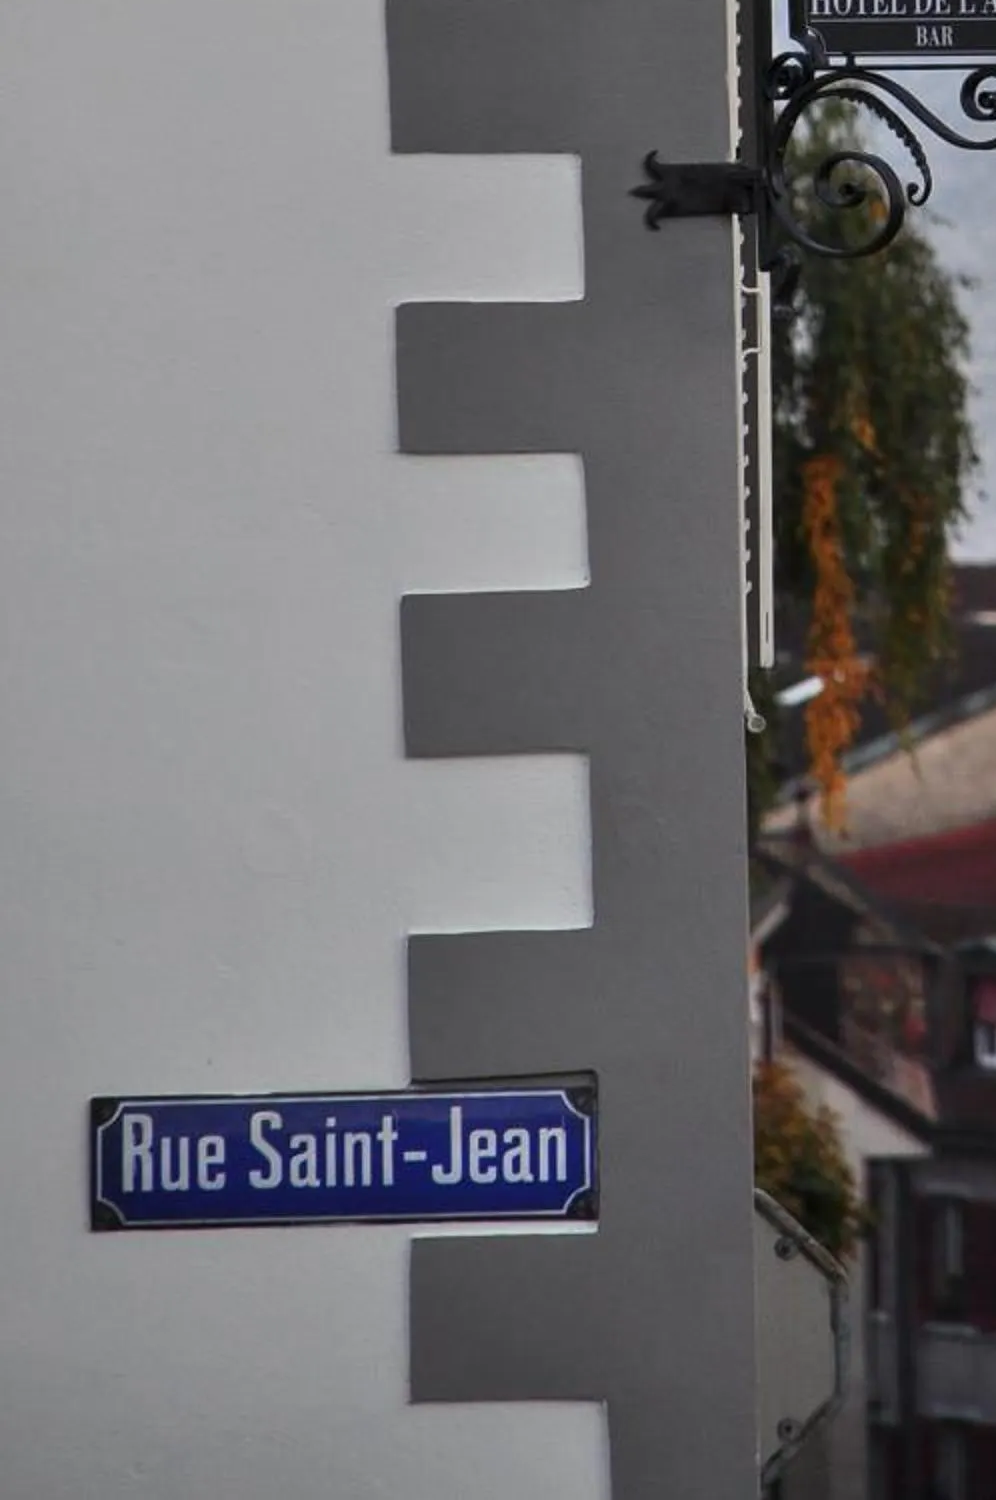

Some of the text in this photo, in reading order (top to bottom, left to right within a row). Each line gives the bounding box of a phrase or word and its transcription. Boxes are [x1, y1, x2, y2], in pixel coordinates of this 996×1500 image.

[916, 26, 954, 46] BAR
[121, 1106, 568, 1193] Rue Saint-Jean
